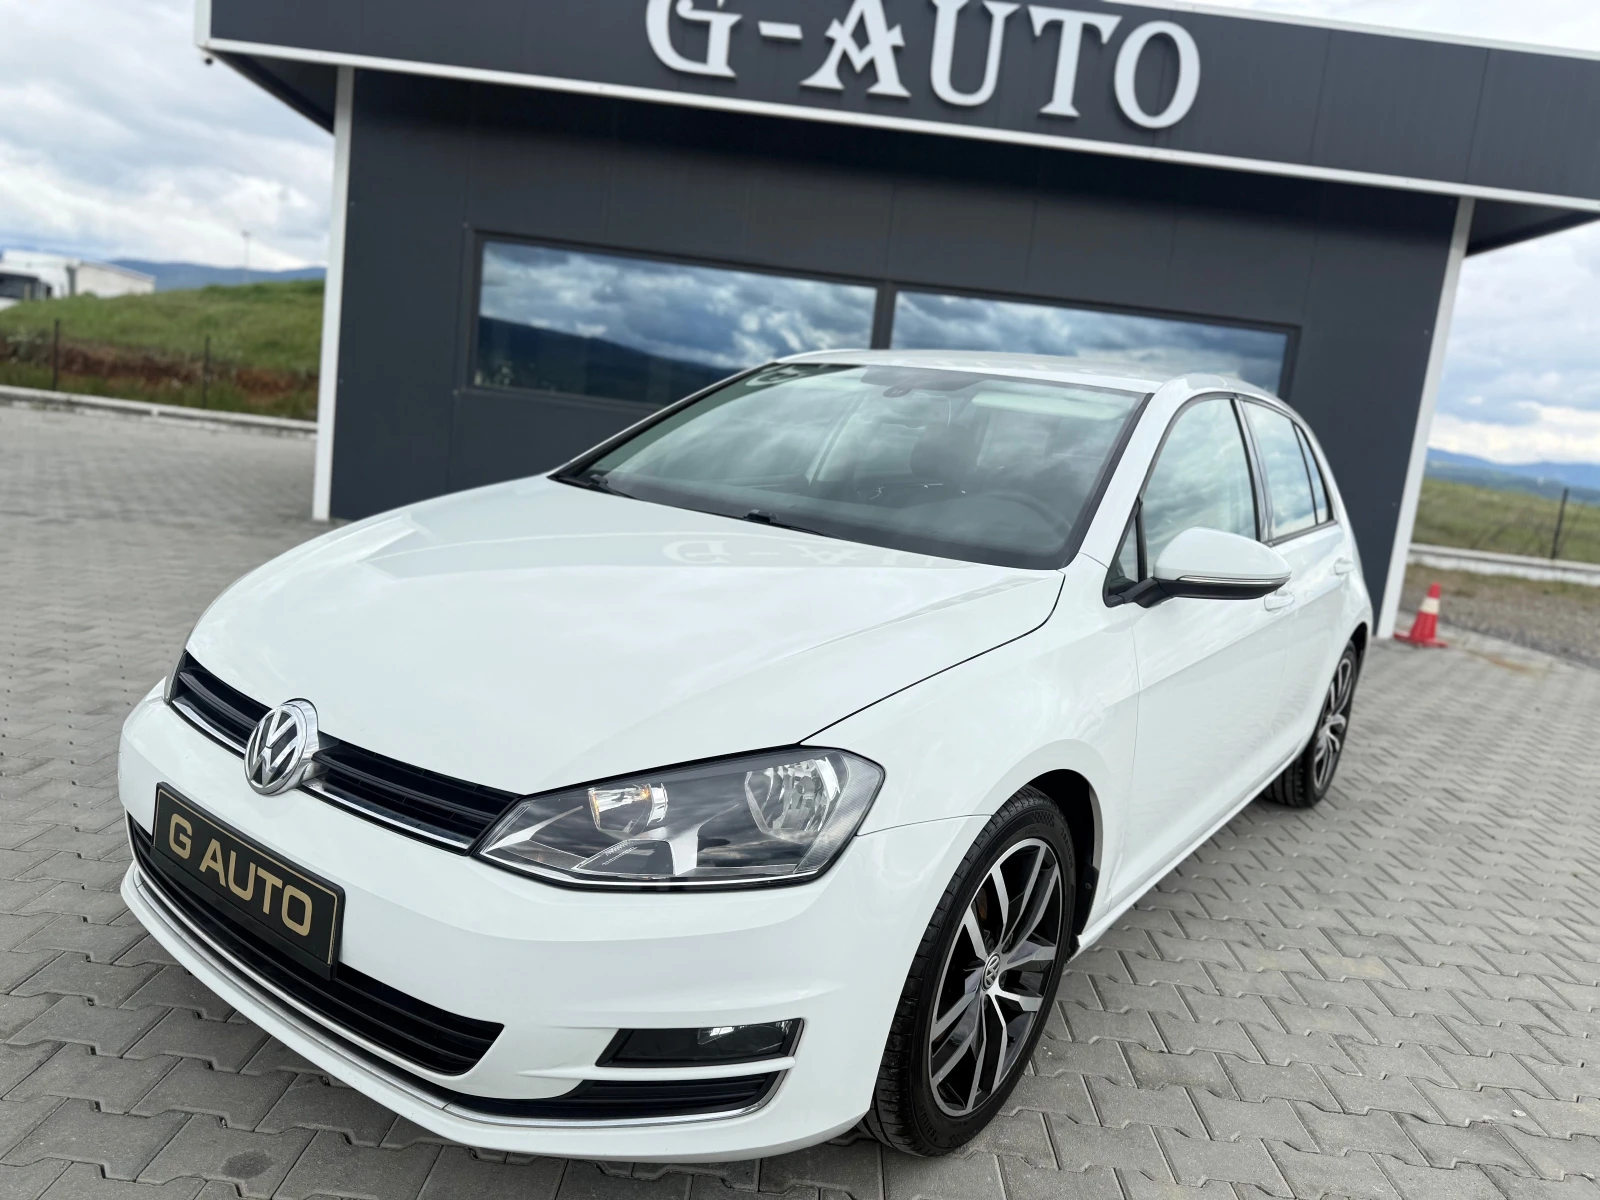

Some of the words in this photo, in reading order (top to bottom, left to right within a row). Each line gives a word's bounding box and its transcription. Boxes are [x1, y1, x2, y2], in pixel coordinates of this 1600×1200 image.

[645, 0, 1200, 128] G-AUTO
[169, 813, 193, 859] G
[199, 838, 313, 936] AUTO
